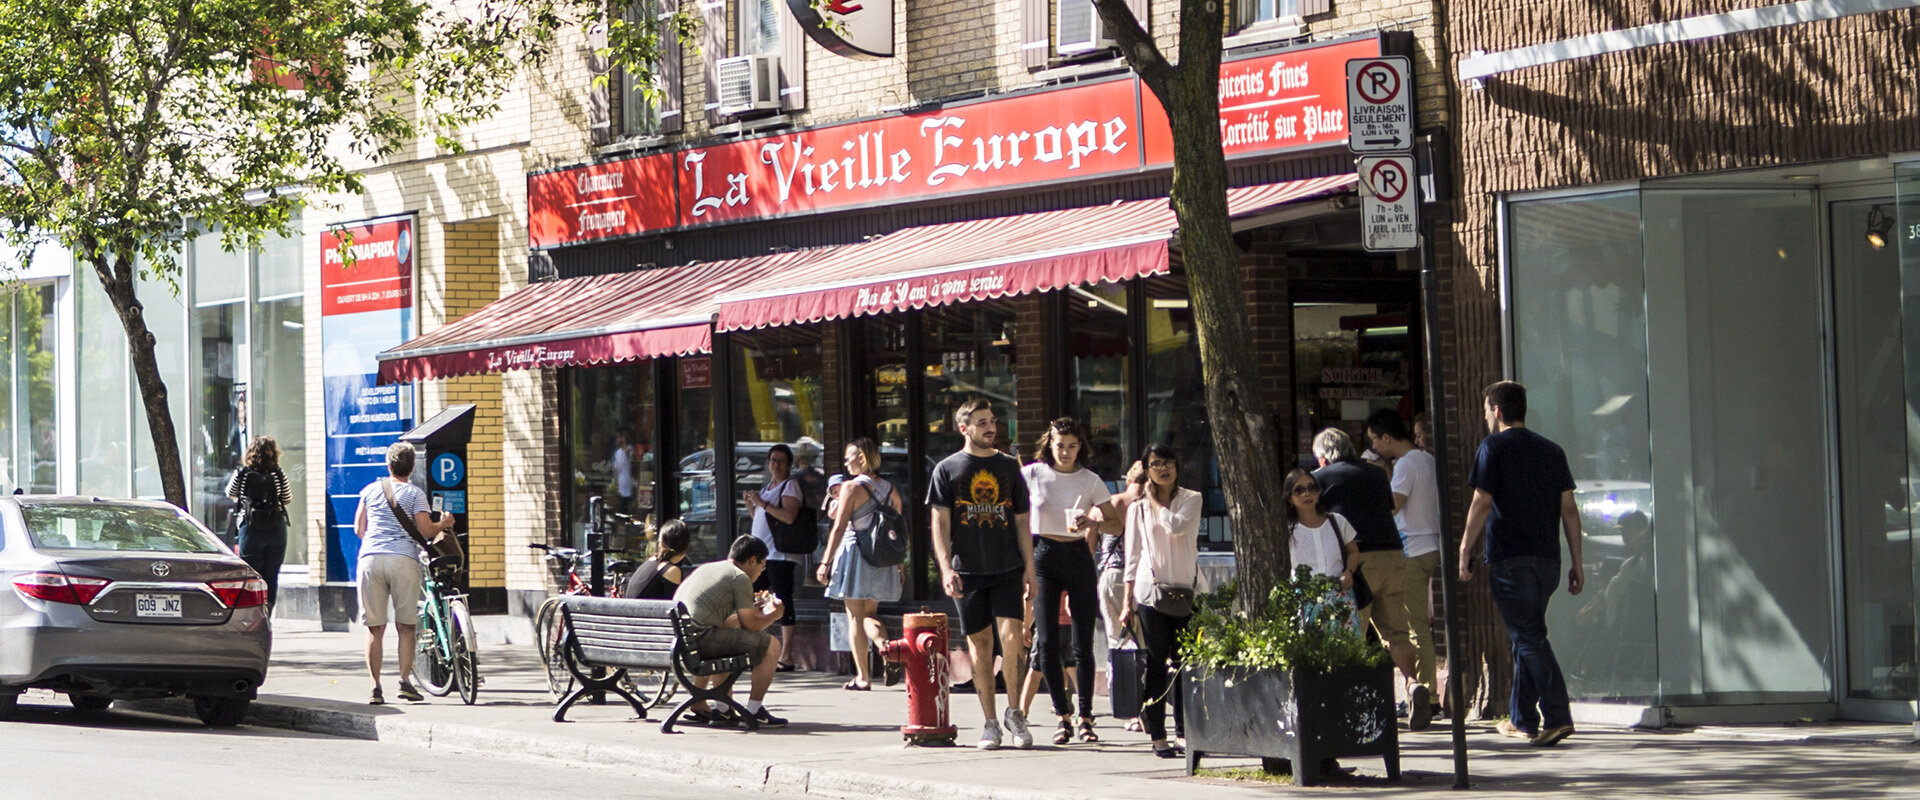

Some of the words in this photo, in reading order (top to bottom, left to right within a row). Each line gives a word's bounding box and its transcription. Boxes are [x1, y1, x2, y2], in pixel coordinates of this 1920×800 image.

[1219, 68, 1264, 104] piceries
[1268, 61, 1308, 97] Fines
[1353, 113, 1407, 124] SEULEMENT
[1354, 104, 1404, 115] LIVRAISON
[1275, 114, 1297, 139] sur
[1303, 105, 1344, 141] Place
[684, 151, 751, 217] La
[761, 129, 912, 207] Vieille
[920, 116, 1128, 187] Europe
[1371, 214, 1385, 223] LUN
[1395, 214, 1409, 222] VEN
[1376, 204, 1386, 213] 7h
[1394, 204, 1403, 213] 8h
[577, 204, 626, 237] Fromagerie
[880, 286, 892, 305] de
[893, 281, 908, 304] 50
[909, 284, 927, 301] ans
[931, 279, 939, 297] à
[941, 278, 966, 295] votre
[969, 270, 1004, 292] service
[488, 352, 502, 369] La
[505, 348, 535, 366] Vieille
[537, 346, 575, 363] Europe
[967, 503, 1005, 520] METALLICA
[138, 599, 156, 611] G09
[162, 599, 180, 611] JNZ
